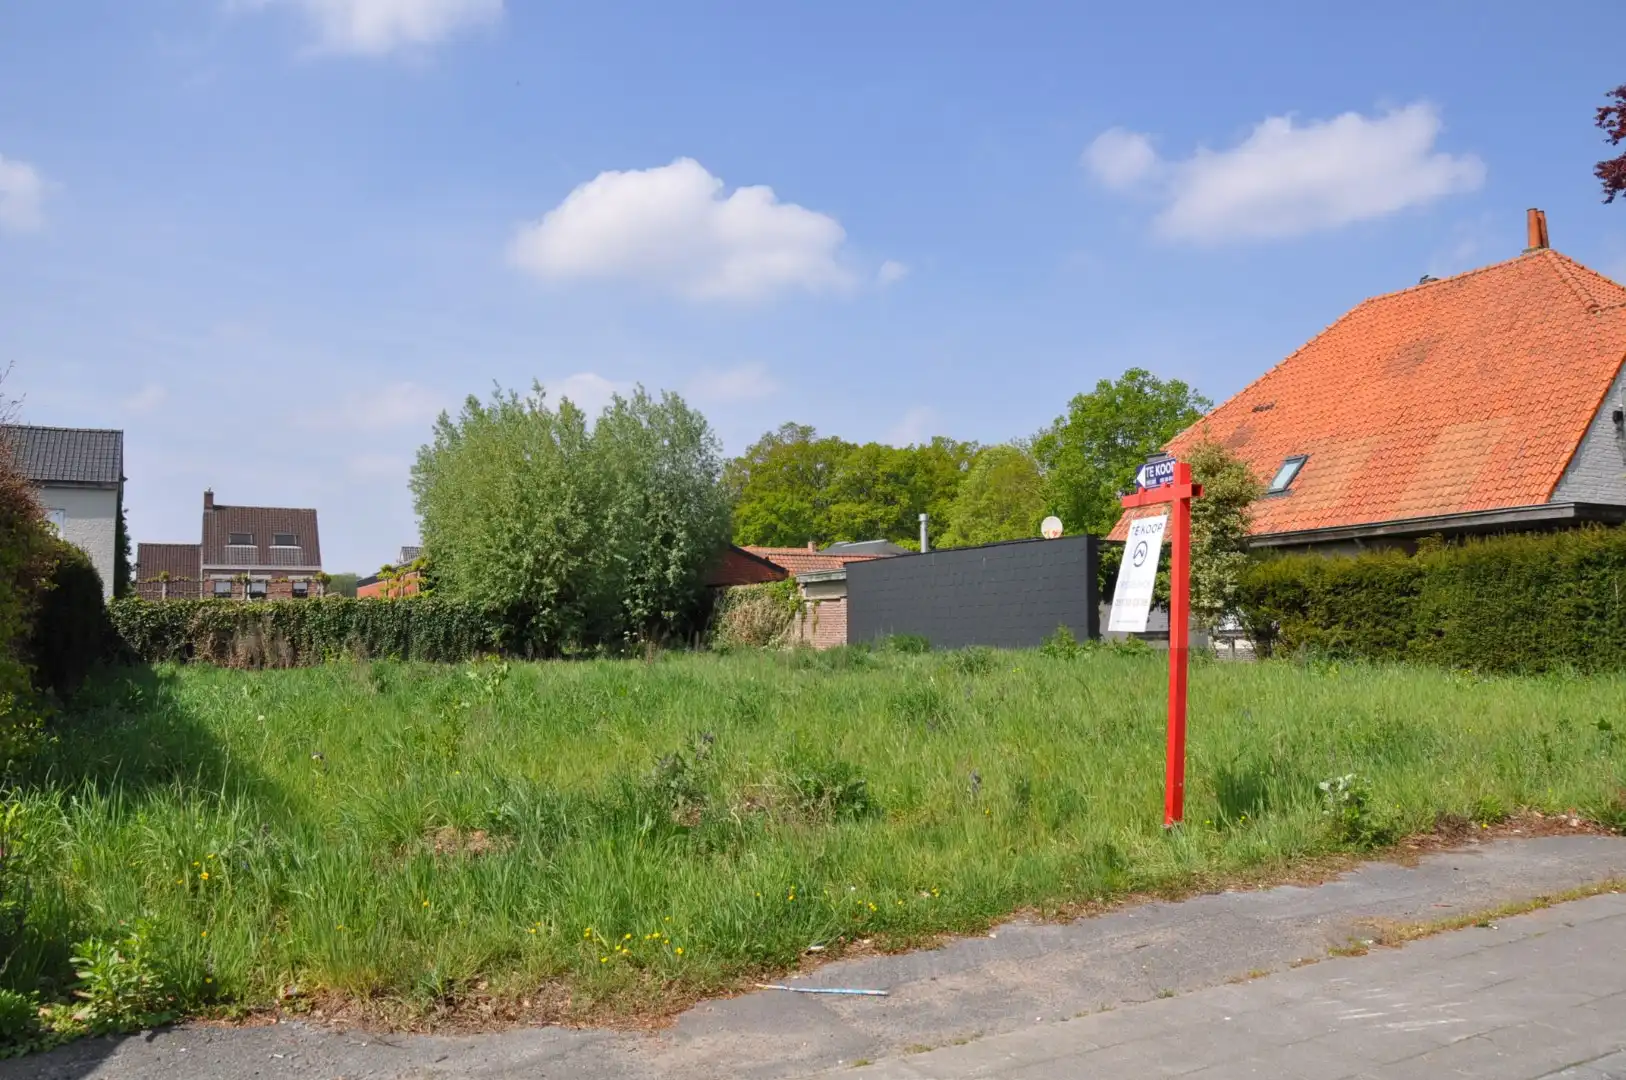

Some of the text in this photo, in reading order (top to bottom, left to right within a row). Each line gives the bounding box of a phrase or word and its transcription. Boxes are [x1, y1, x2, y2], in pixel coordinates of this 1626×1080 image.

[1146, 466, 1154, 478] TE
[1132, 523, 1162, 536] TE KOOP
